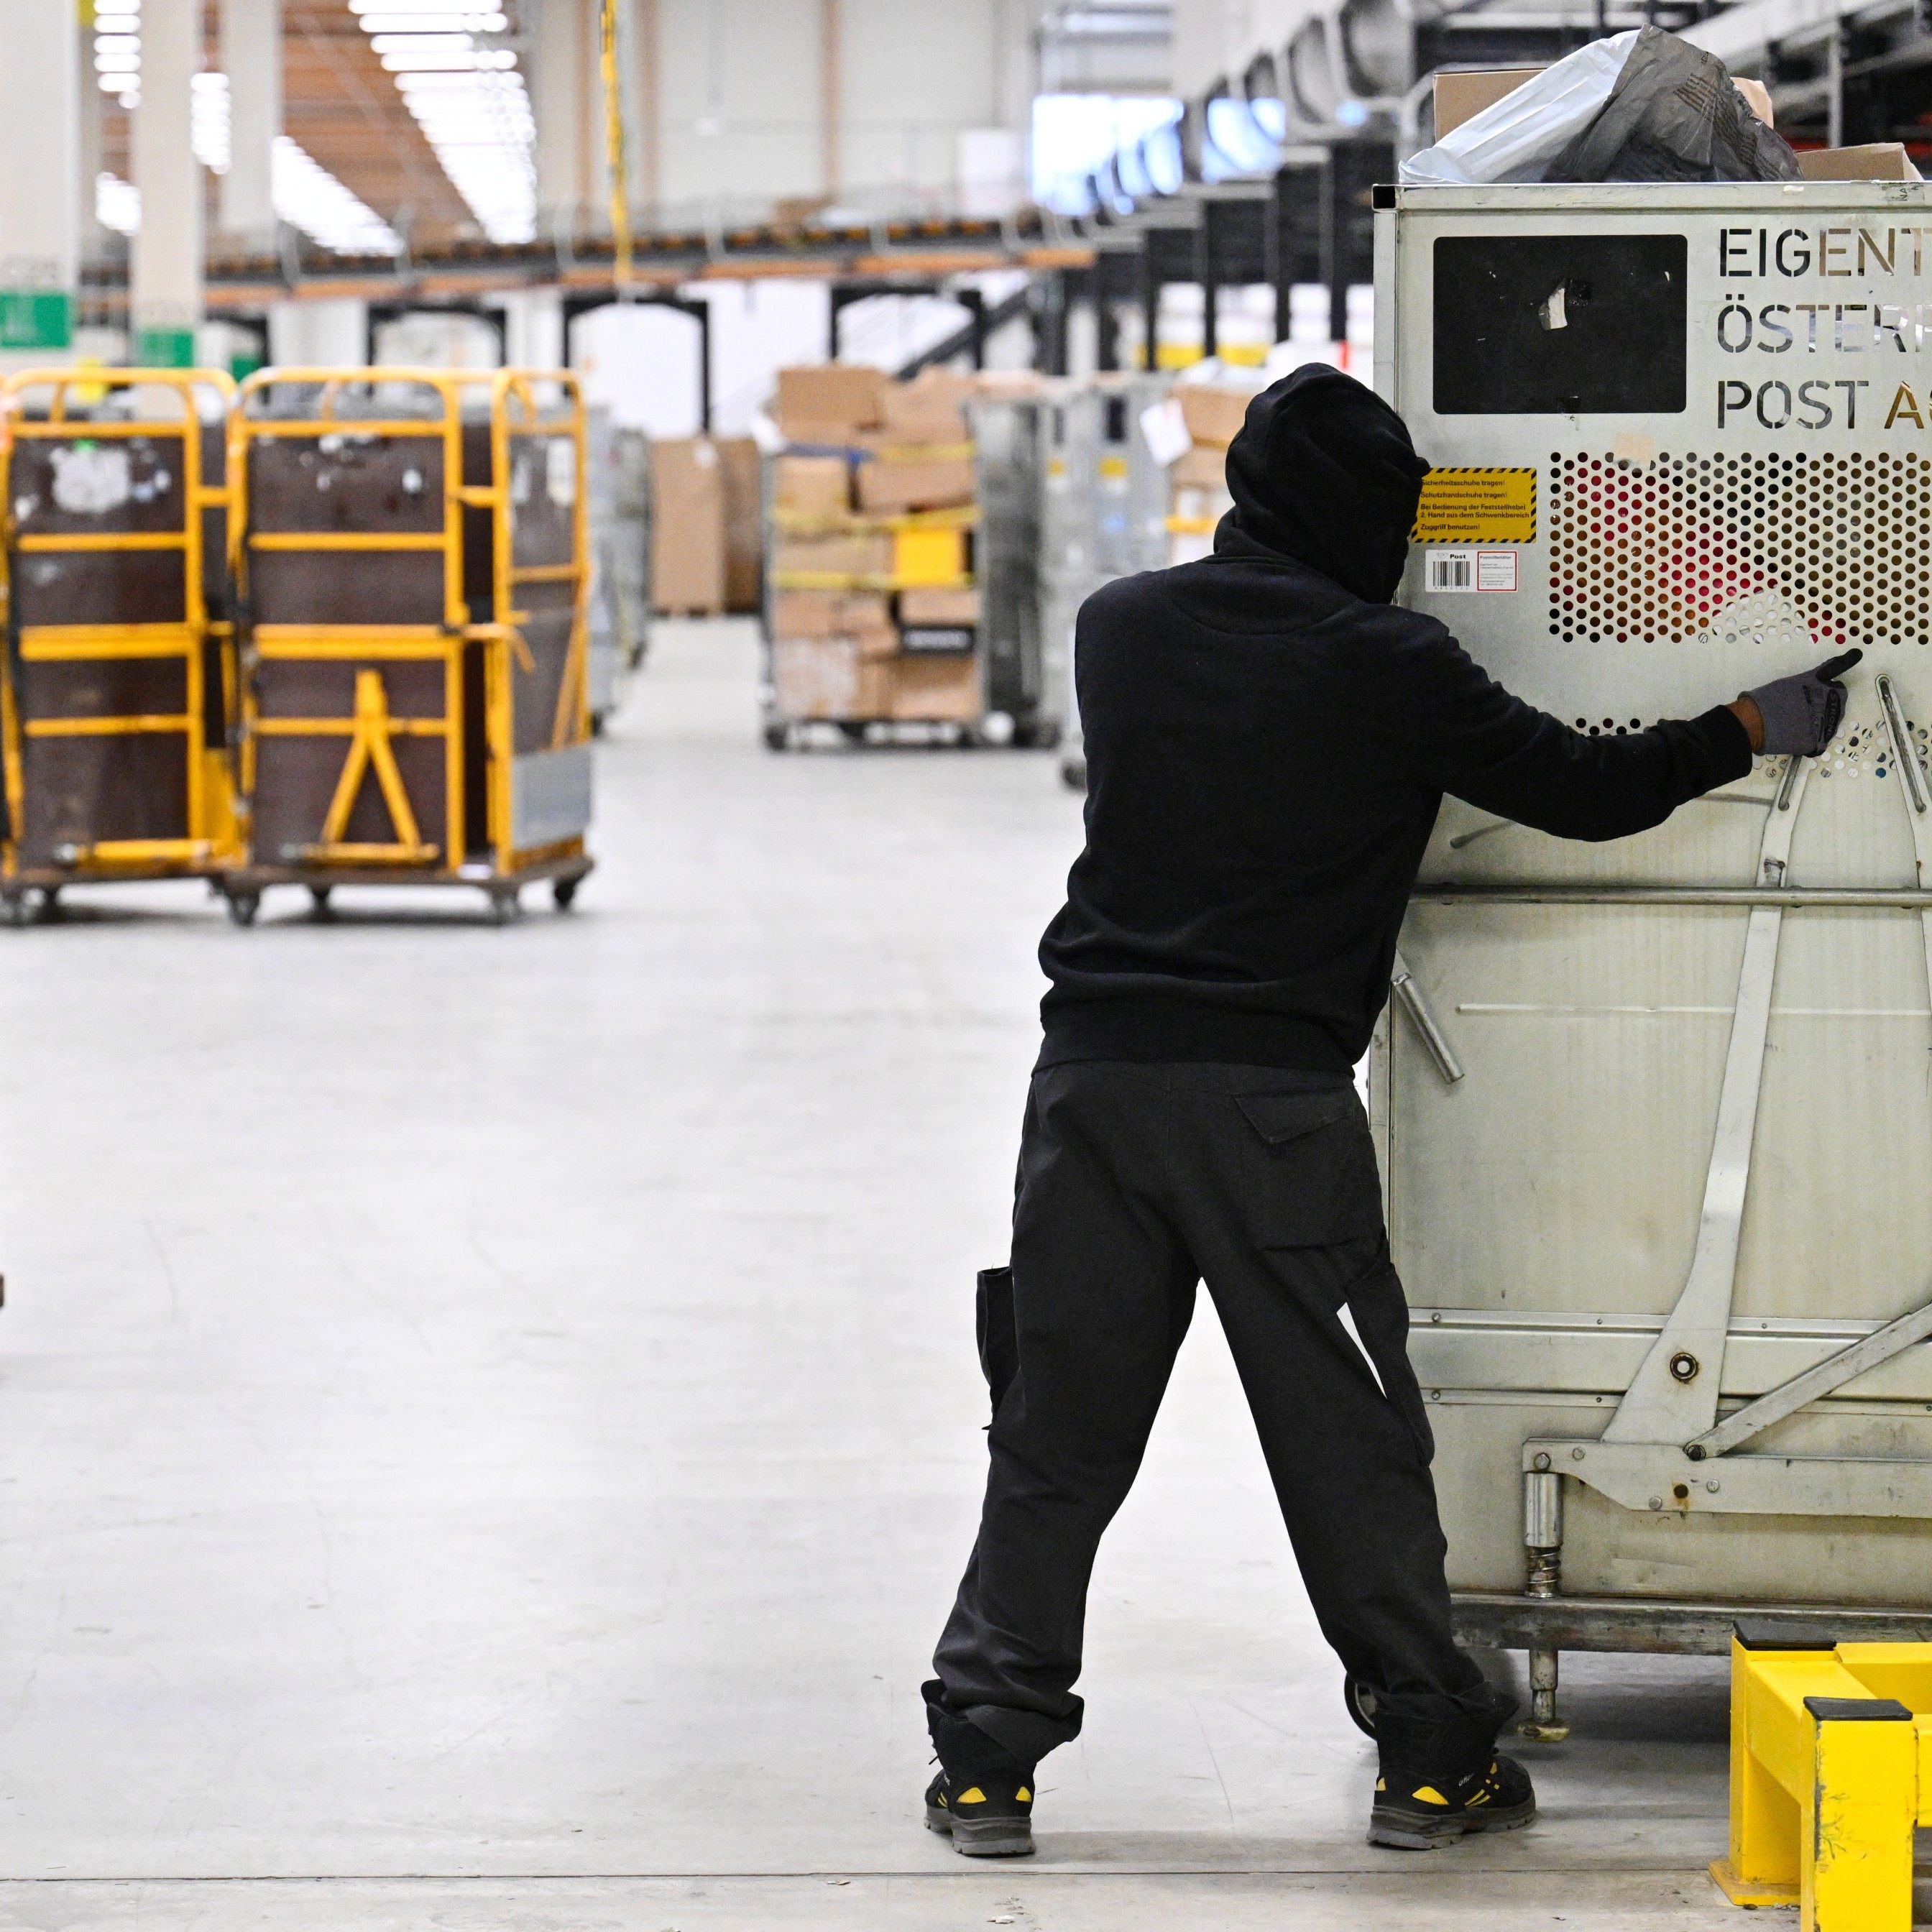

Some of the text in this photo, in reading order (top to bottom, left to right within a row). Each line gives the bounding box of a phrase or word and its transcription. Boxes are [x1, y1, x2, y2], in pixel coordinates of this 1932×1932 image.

[1720, 228, 1932, 277] EIGENT
[1718, 380, 1932, 429] POST A
